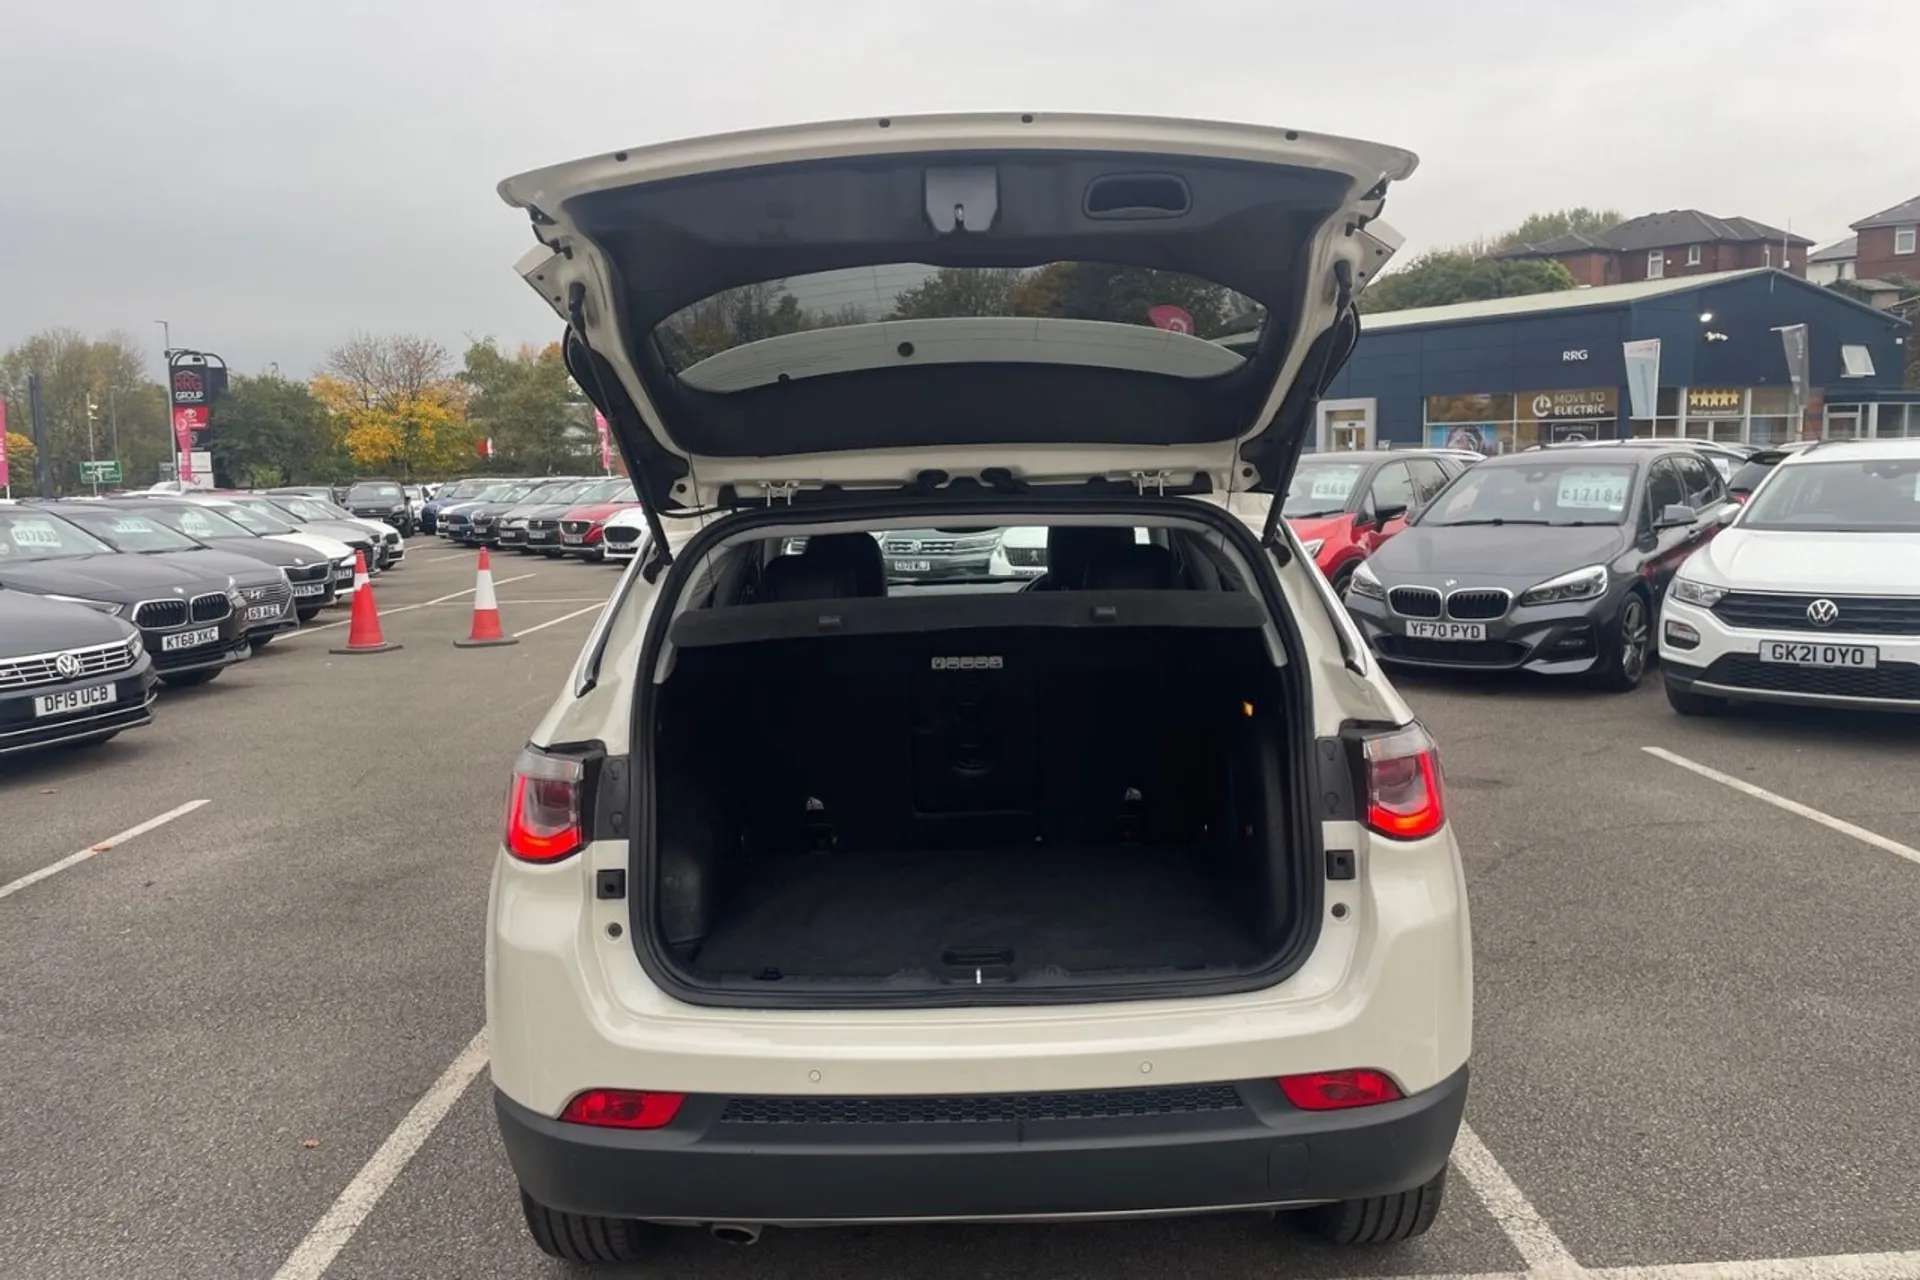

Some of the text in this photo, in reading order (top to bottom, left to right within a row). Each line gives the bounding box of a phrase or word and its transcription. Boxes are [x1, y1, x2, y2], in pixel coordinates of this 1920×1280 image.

[1562, 349, 1589, 361] RRG
[175, 391, 204, 400] GROUP
[1554, 391, 1606, 404] MOVE TO
[1554, 403, 1606, 416] ELECTRIC
[1411, 623, 1480, 638] YF70 PYD
[166, 629, 217, 649] KT68 XKC
[1772, 644, 1864, 665] GK21 OYO
[44, 686, 108, 712] DF19 UCB
